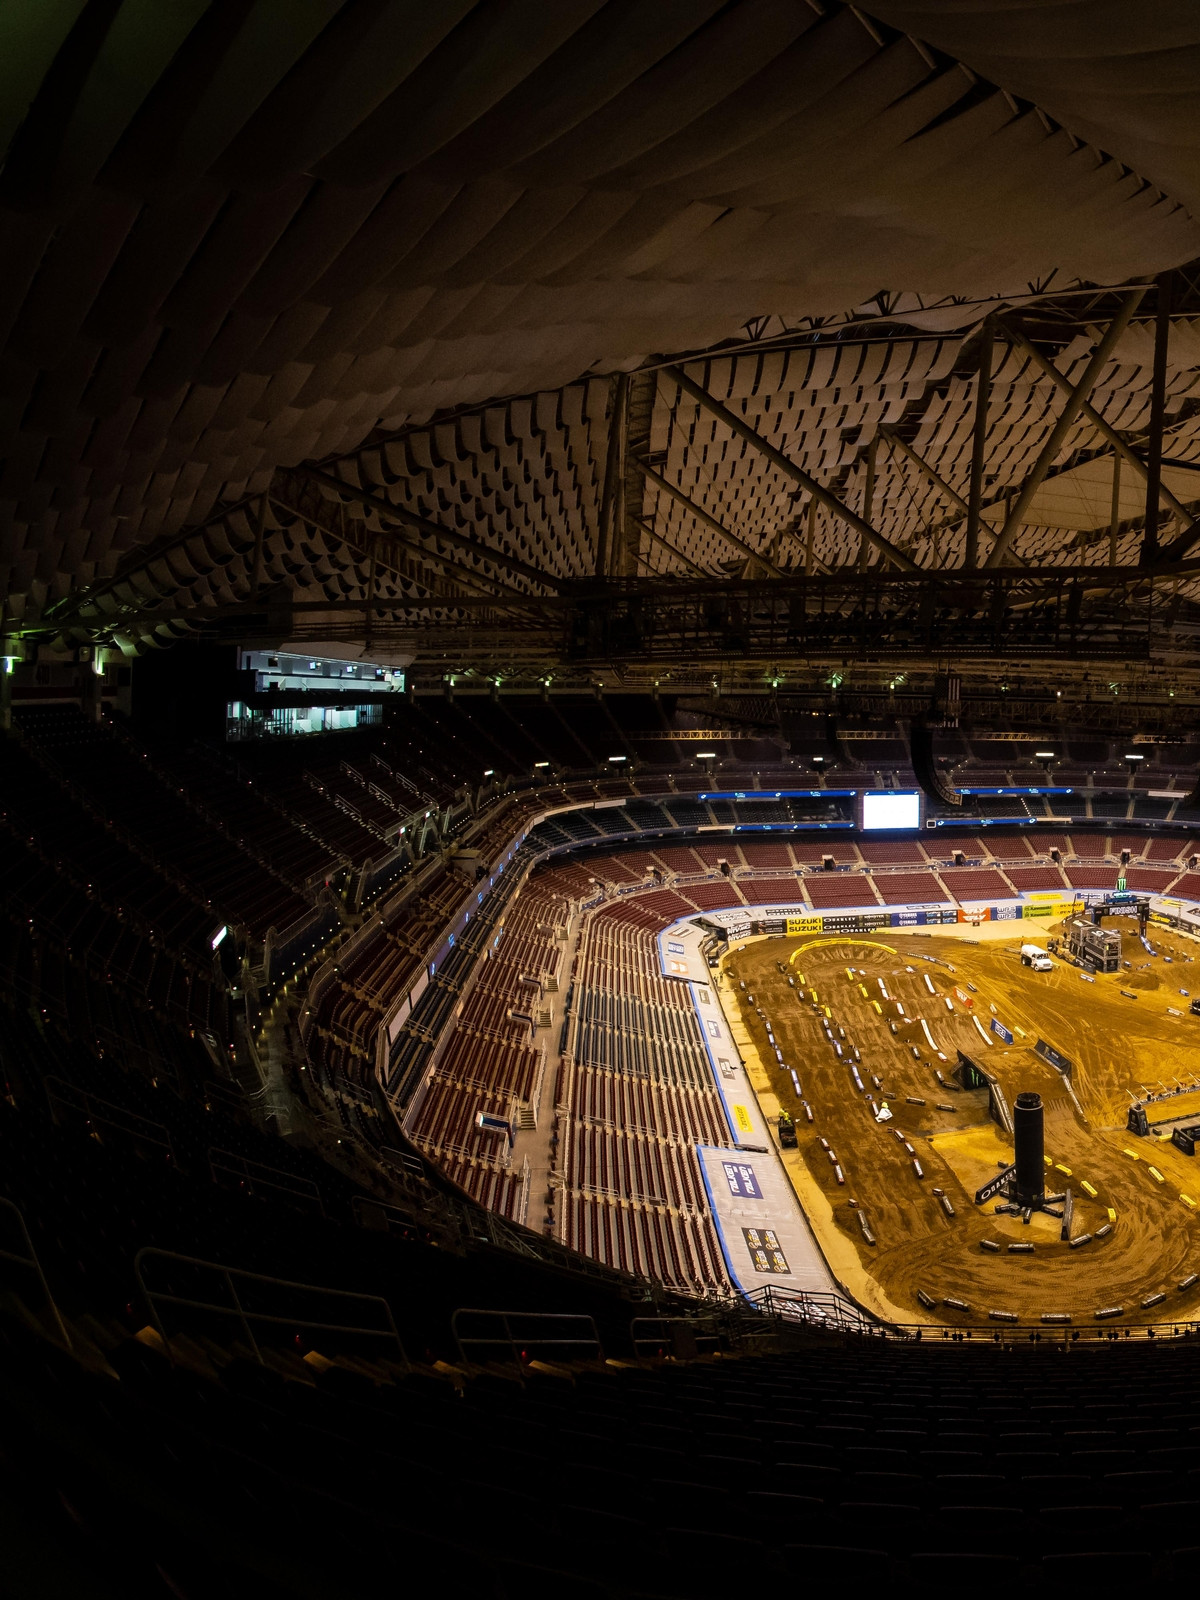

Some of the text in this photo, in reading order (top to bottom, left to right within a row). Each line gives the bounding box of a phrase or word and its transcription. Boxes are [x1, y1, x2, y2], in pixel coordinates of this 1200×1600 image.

[1109, 905, 1138, 915] FINISH
[788, 917, 822, 925] SUZUKI
[788, 925, 822, 933] SUZUKI
[724, 1164, 740, 1193] FALKEN
[739, 1166, 756, 1195] FALKEN
